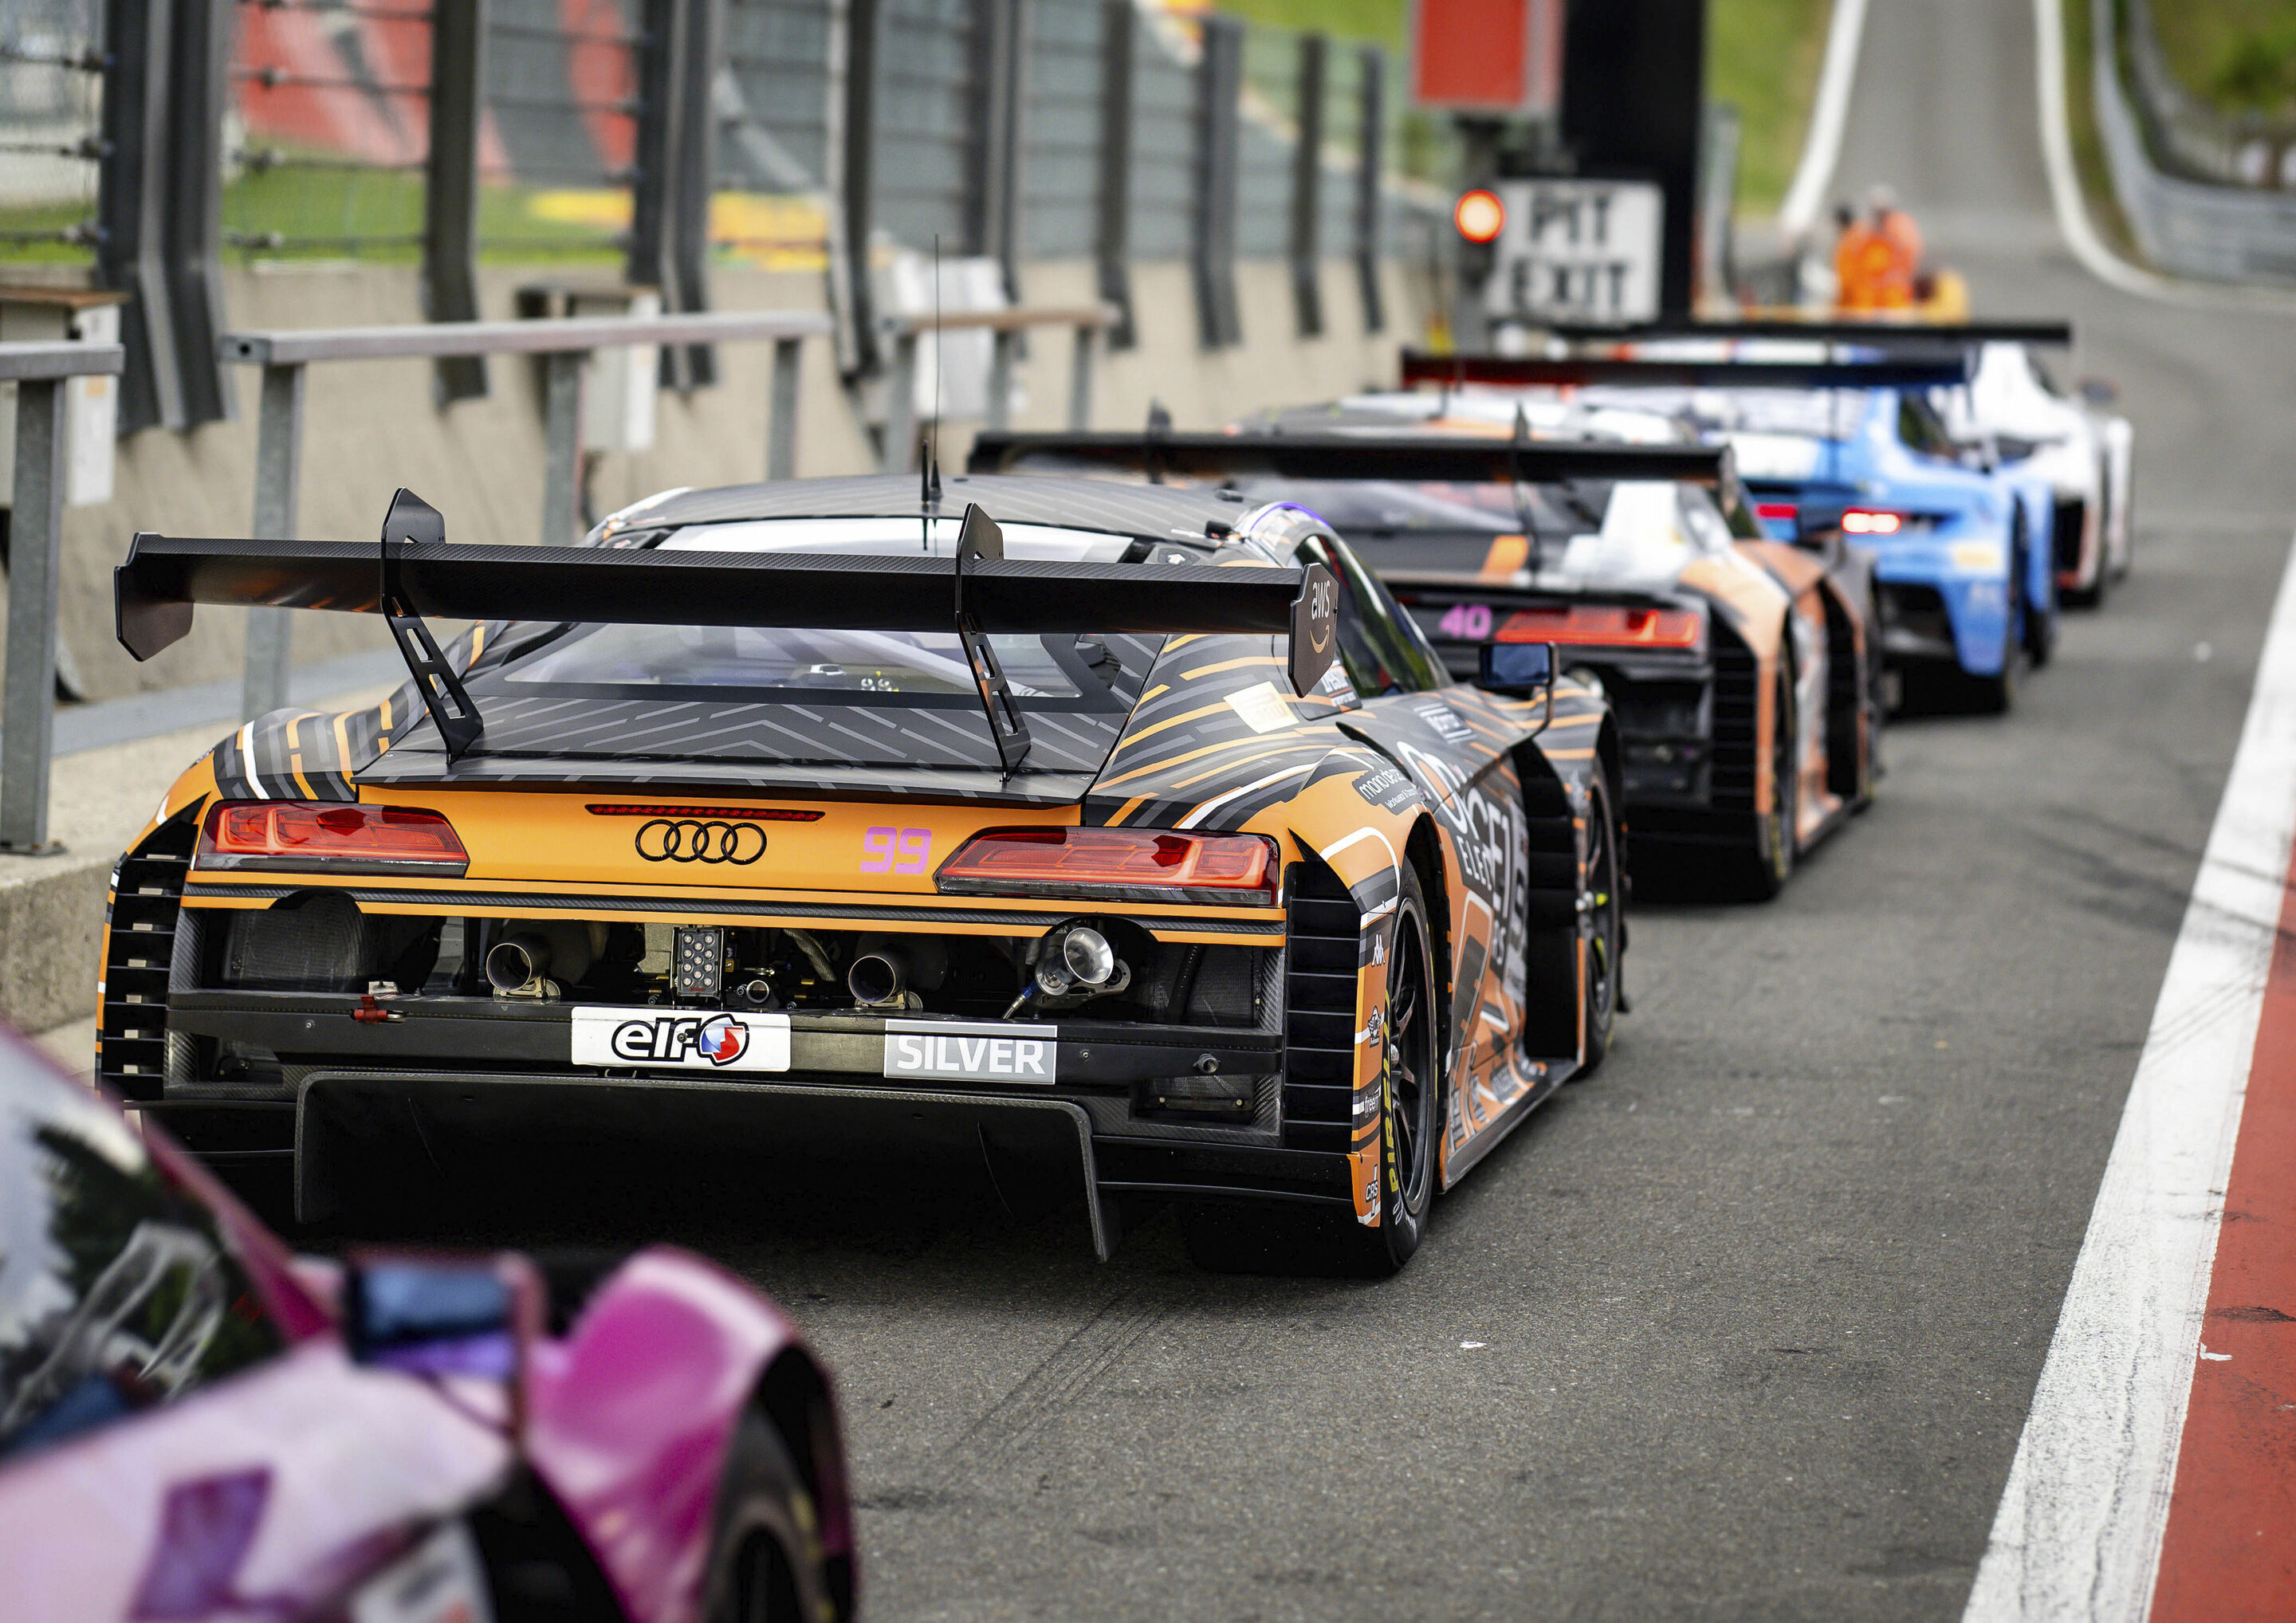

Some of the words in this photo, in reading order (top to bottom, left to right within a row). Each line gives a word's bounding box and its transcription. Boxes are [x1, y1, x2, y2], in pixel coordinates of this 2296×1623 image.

[1529, 192, 1613, 245] PIT
[1511, 257, 1630, 309] EXIT
[1311, 580, 1331, 620] aws
[1438, 604, 1492, 640] 40
[860, 826, 932, 874] 99
[611, 1017, 702, 1062] elf
[896, 1035, 1046, 1075] SILVER
[1383, 988, 1398, 1193] PIRELLI
[1366, 1181, 1378, 1201] CRS
